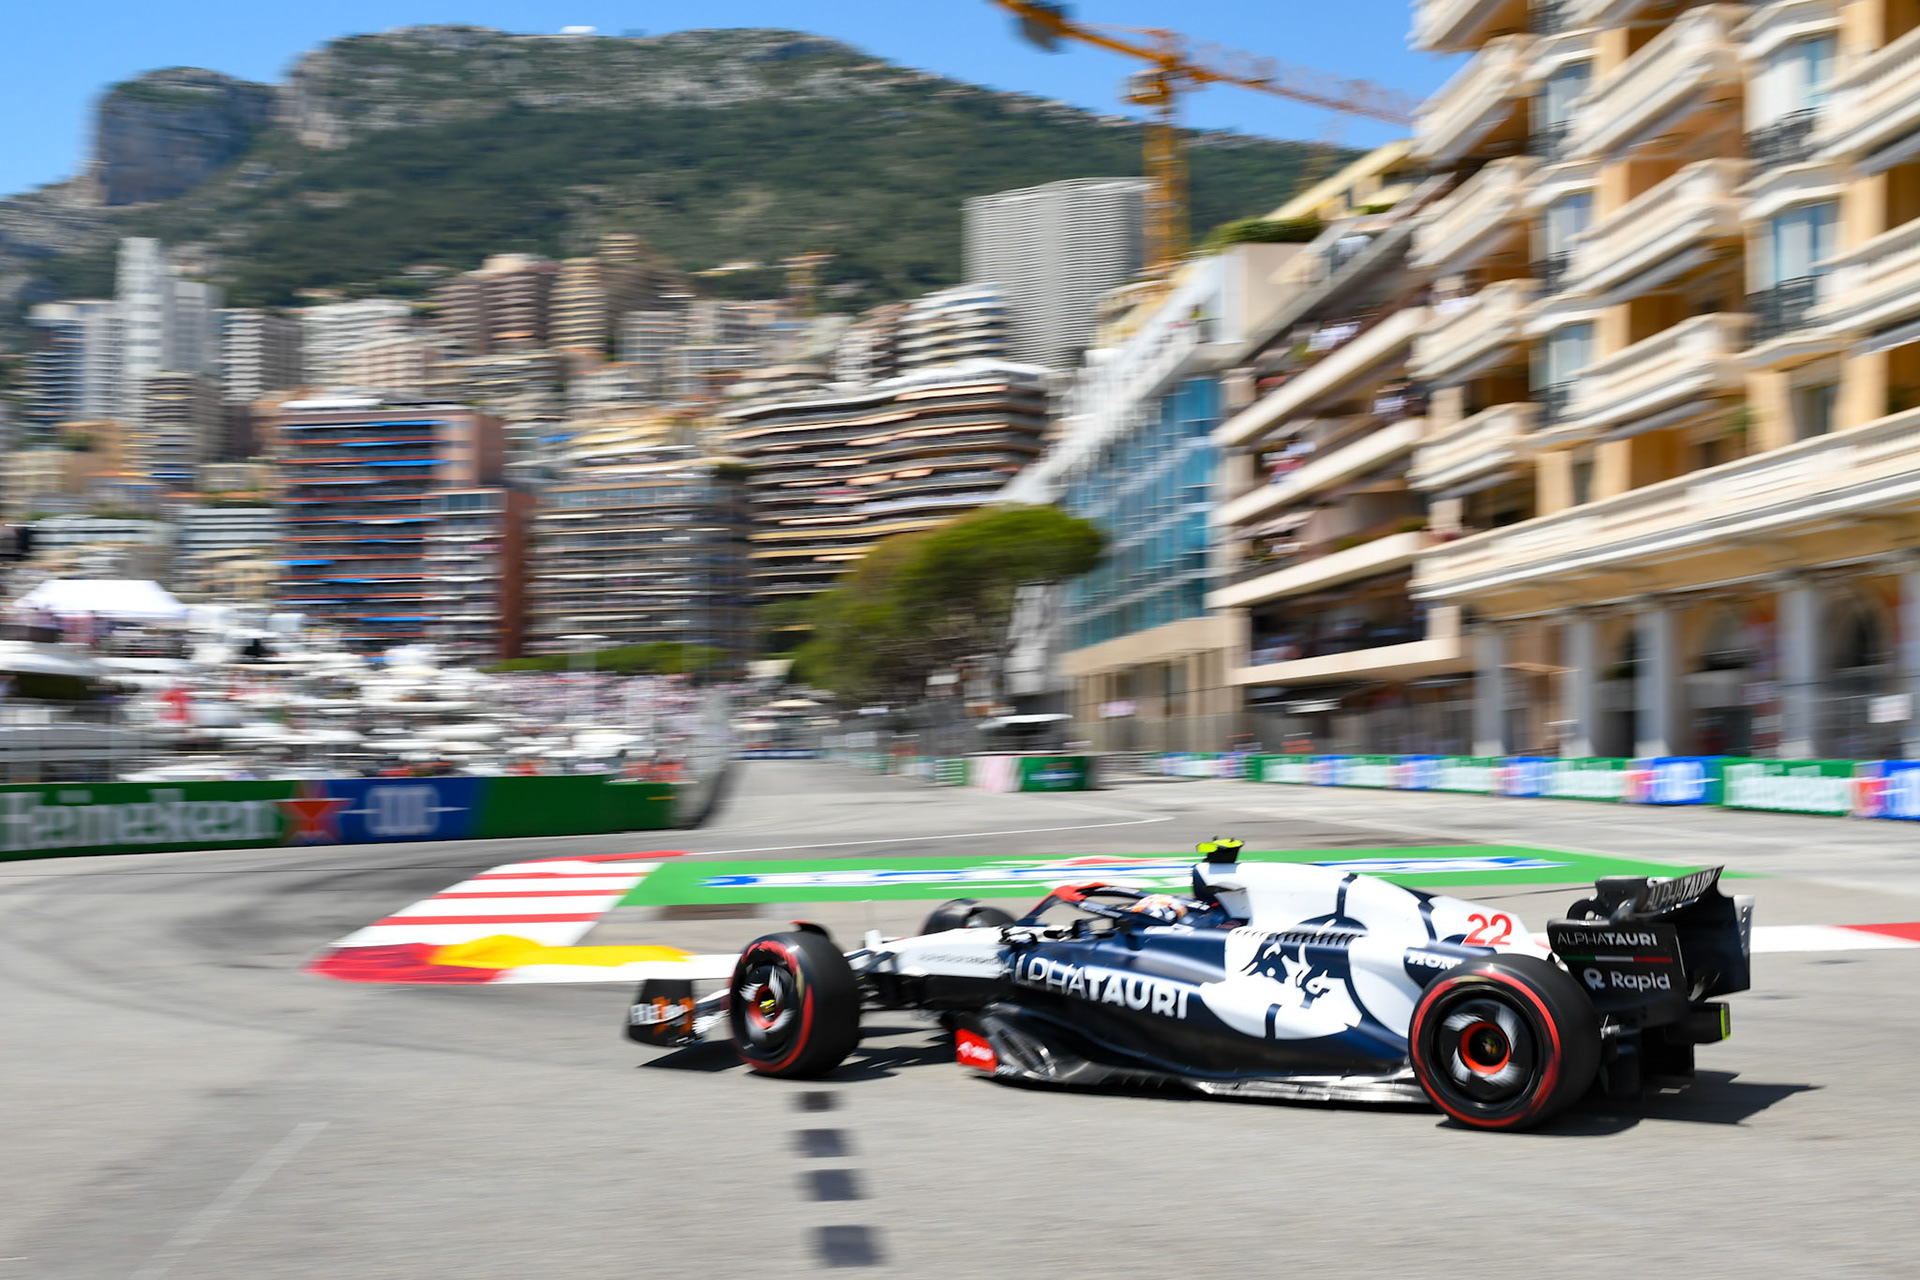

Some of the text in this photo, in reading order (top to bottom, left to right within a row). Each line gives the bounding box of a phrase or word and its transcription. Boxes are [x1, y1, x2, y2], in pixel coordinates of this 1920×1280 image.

[1463, 913, 1512, 947] 22
[1557, 932, 1658, 946] ALPHATAURI
[1407, 951, 1462, 970] HON
[1610, 970, 1671, 992] Rapid
